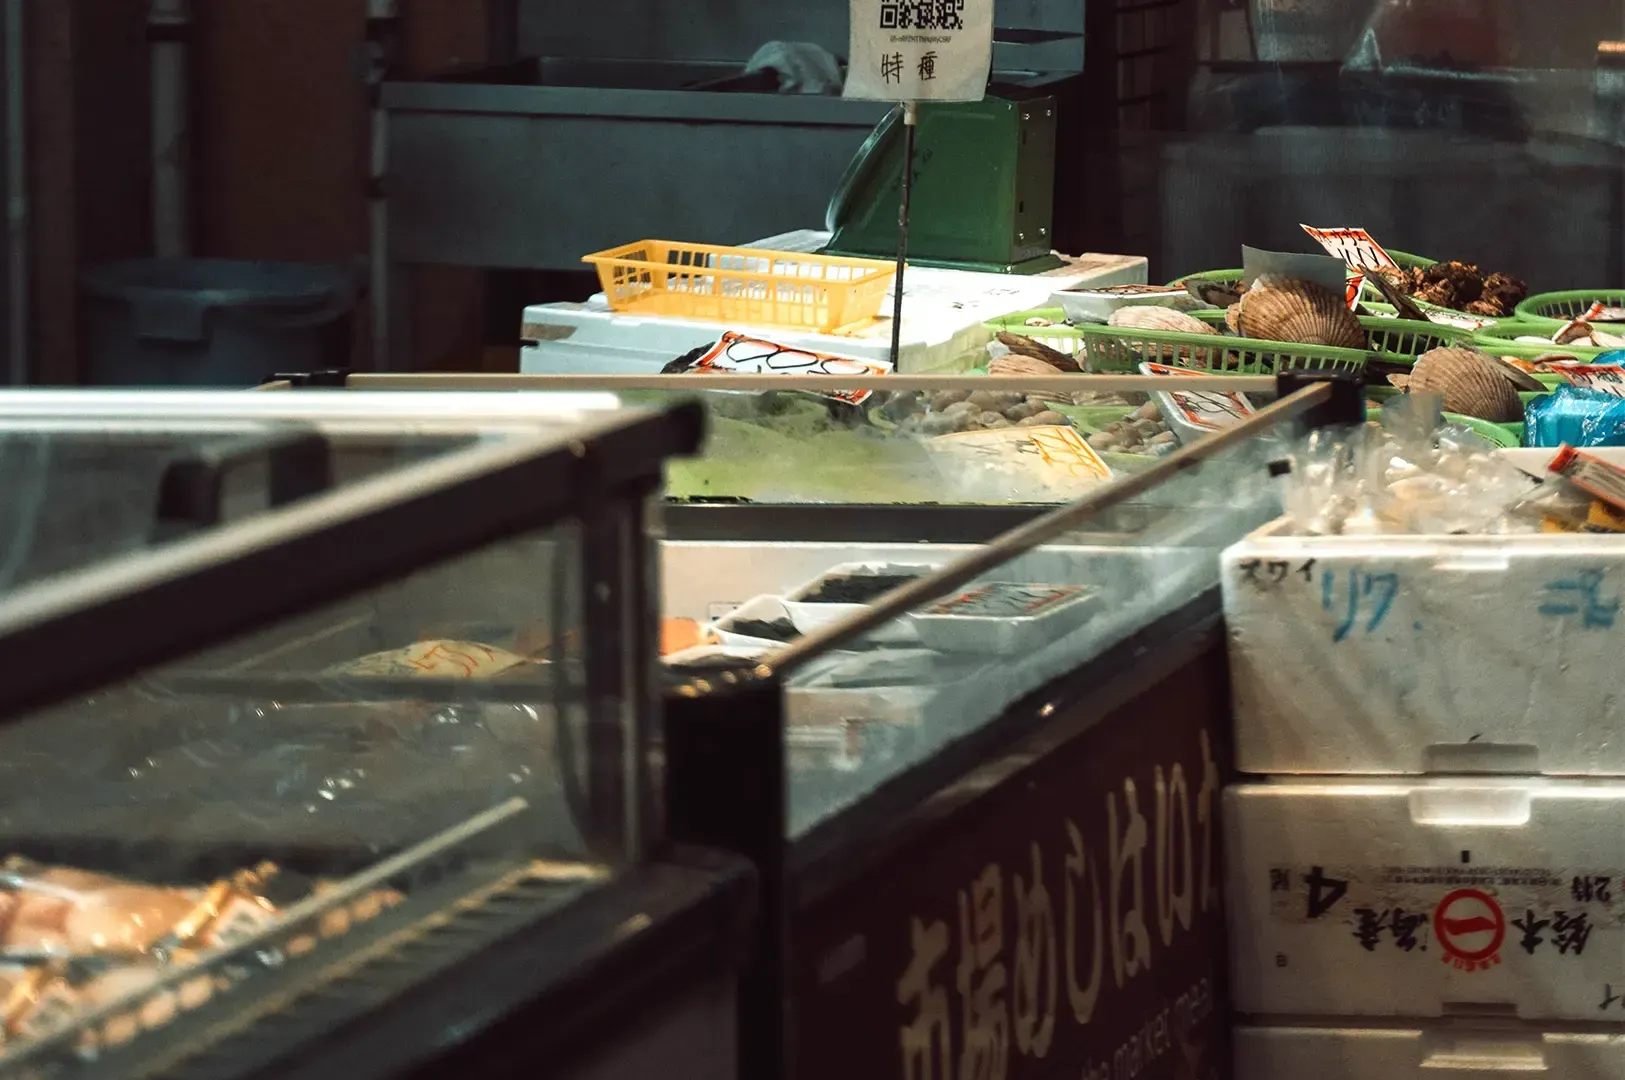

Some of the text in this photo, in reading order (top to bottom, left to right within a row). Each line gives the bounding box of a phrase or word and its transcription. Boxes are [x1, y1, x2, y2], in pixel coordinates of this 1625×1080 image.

[1305, 866, 1348, 919] 4
[1352, 907, 1594, 956] 鈴木 海産
